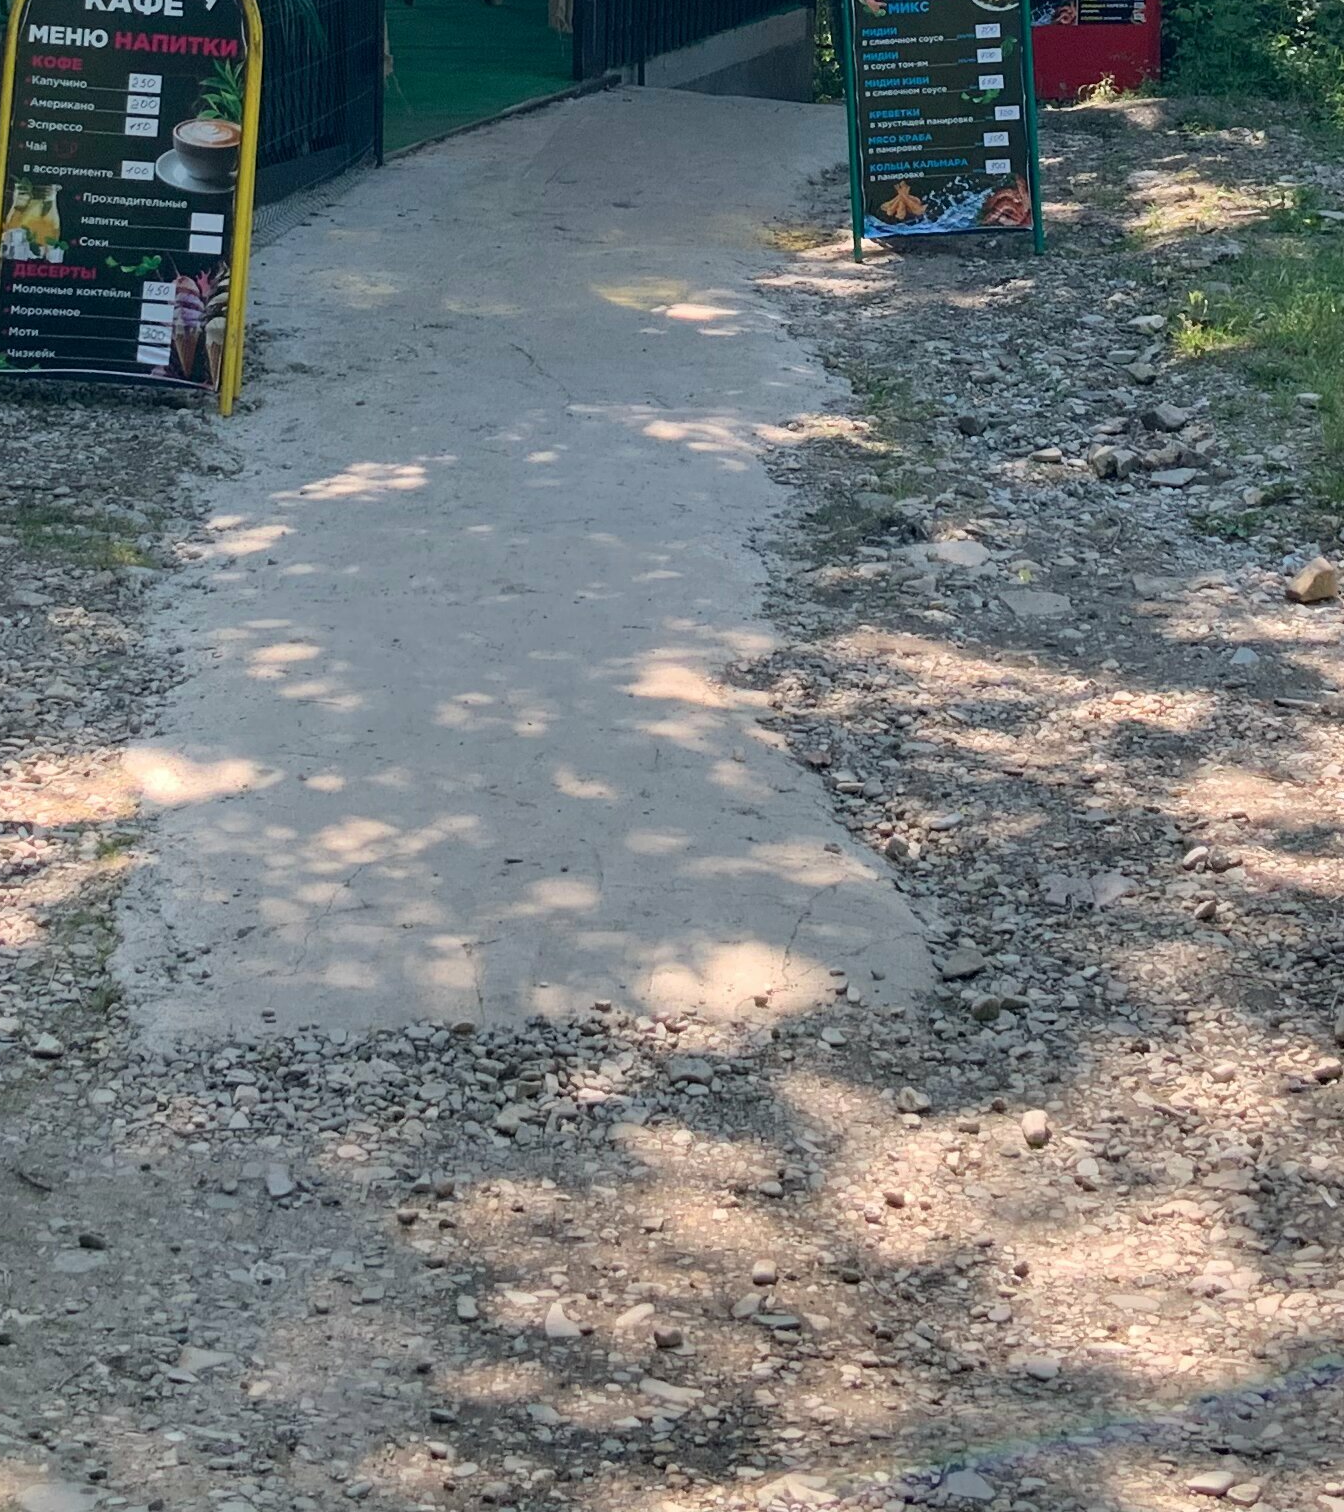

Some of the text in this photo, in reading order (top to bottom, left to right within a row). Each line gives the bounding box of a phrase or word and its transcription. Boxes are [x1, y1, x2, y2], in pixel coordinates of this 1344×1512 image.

[888, 1, 929, 14] МИКС
[28, 24, 238, 57] МЕНЮ НАПИТКИ
[32, 55, 83, 70] КОФЕ
[32, 75, 156, 89] Капучино 250
[30, 97, 157, 111] Американо 200
[27, 119, 83, 132] Эспрессо
[25, 140, 47, 151] Чай
[868, 134, 932, 144] МЯСО КРАБА
[23, 164, 30, 172] в
[33, 165, 114, 178] ассортименте
[870, 159, 968, 171] КОЛЬЦА КАЛЬМАРА
[83, 192, 187, 209] Прохладительные
[81, 216, 128, 227] напитки
[79, 237, 109, 247] Соки
[12, 263, 96, 280] ДЕСЕРТЫ
[12, 284, 73, 296] Молочные
[76, 288, 131, 298] коктейли
[10, 305, 80, 318] Мороженое
[8, 326, 39, 337] Моти
[7, 347, 56, 359] Чизкейк
